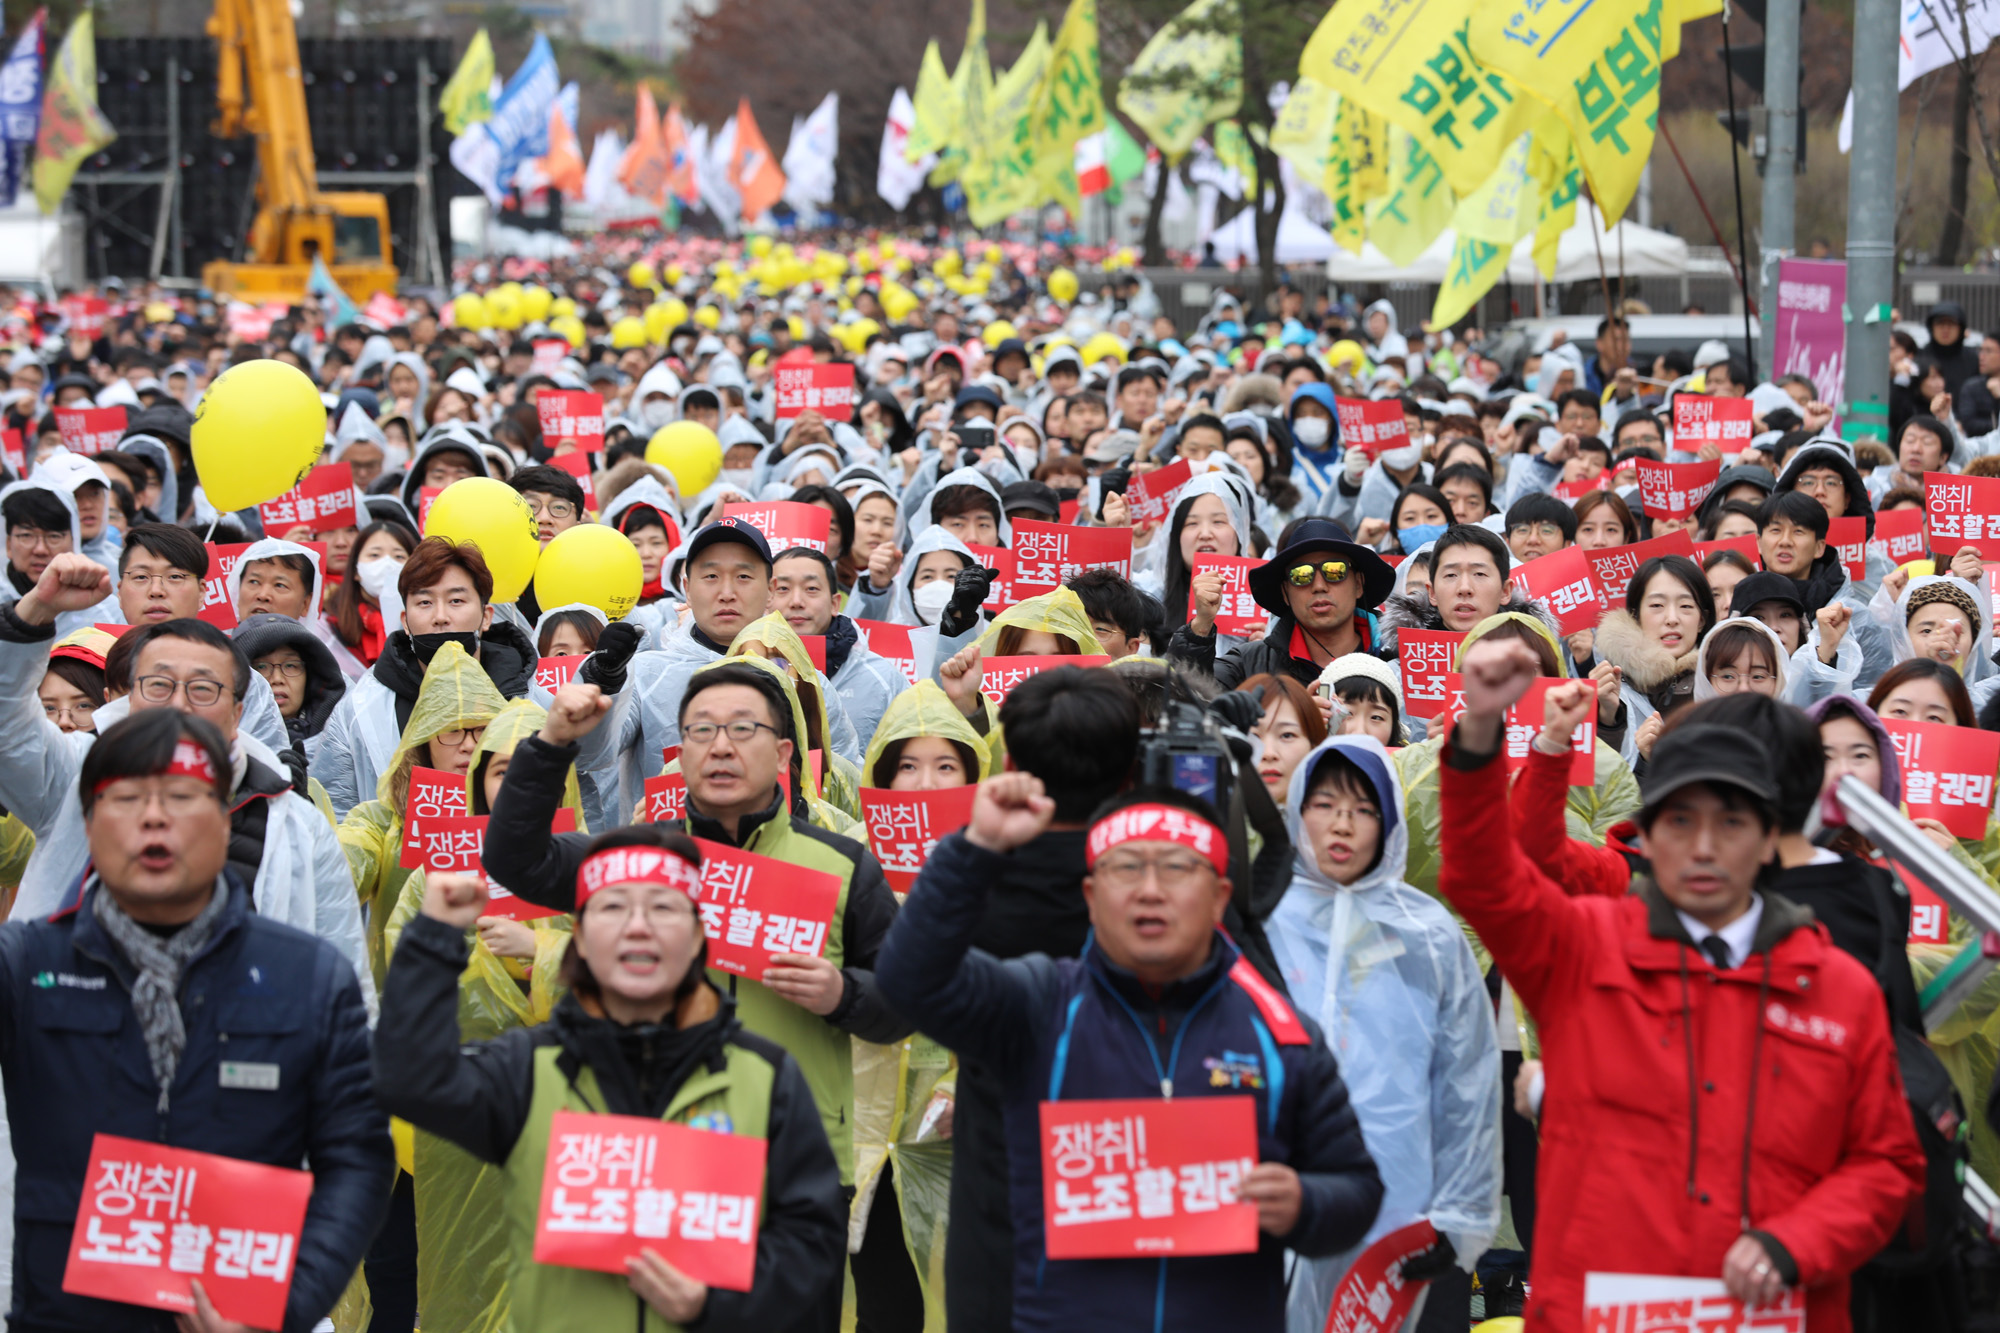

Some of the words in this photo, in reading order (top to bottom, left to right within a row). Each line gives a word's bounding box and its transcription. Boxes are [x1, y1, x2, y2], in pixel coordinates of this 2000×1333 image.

[778, 389, 805, 408] 노조
[805, 388, 821, 407] 할
[822, 386, 851, 406] 권리
[1678, 400, 1712, 422] 쟁취!
[1340, 423, 1361, 443] 노조
[1361, 423, 1376, 443] 할
[1375, 419, 1407, 440] 권리
[1676, 419, 1704, 440] 노조
[1706, 419, 1721, 439] 할
[1722, 419, 1751, 439] 권리
[1638, 467, 1673, 492] 쟁취!
[262, 503, 297, 525] 노조
[297, 500, 317, 523] 할
[316, 487, 354, 516] 권리
[1642, 489, 1668, 511] 노조
[1668, 491, 1687, 512] 할
[1929, 484, 1972, 512] 쟁취!
[1930, 514, 1961, 538] 노조
[1963, 514, 1985, 540] 할
[1016, 531, 1068, 561] 쟁취!
[1890, 532, 1923, 558] 권리
[1015, 561, 1057, 586] 노조
[200, 577, 227, 611] 리
[1235, 593, 1256, 617] 할
[1551, 577, 1595, 614] 권리
[1407, 674, 1446, 701] 노조
[1506, 723, 1536, 758] 할
[1890, 732, 1922, 770] 취!
[1905, 771, 1937, 804] 할
[1939, 773, 1992, 807] 권리
[867, 801, 931, 840] 쟁취!
[877, 841, 922, 874] 노조
[700, 857, 753, 906] 취!
[699, 902, 725, 940] 조
[726, 907, 763, 948] 할
[762, 914, 826, 957] 권리
[1907, 904, 1941, 940] 리
[555, 1133, 657, 1188] 쟁취!
[1051, 1115, 1147, 1178] 쟁취!
[94, 1160, 197, 1220] 쟁취!
[1053, 1172, 1132, 1226] 노조
[1133, 1167, 1176, 1220] 할
[1179, 1157, 1254, 1214] 권리
[546, 1186, 628, 1235] 노조
[633, 1187, 677, 1239] 할
[678, 1190, 755, 1244] 권리
[79, 1215, 166, 1268] 노조
[170, 1220, 213, 1274] 할
[214, 1228, 294, 1283] 권리
